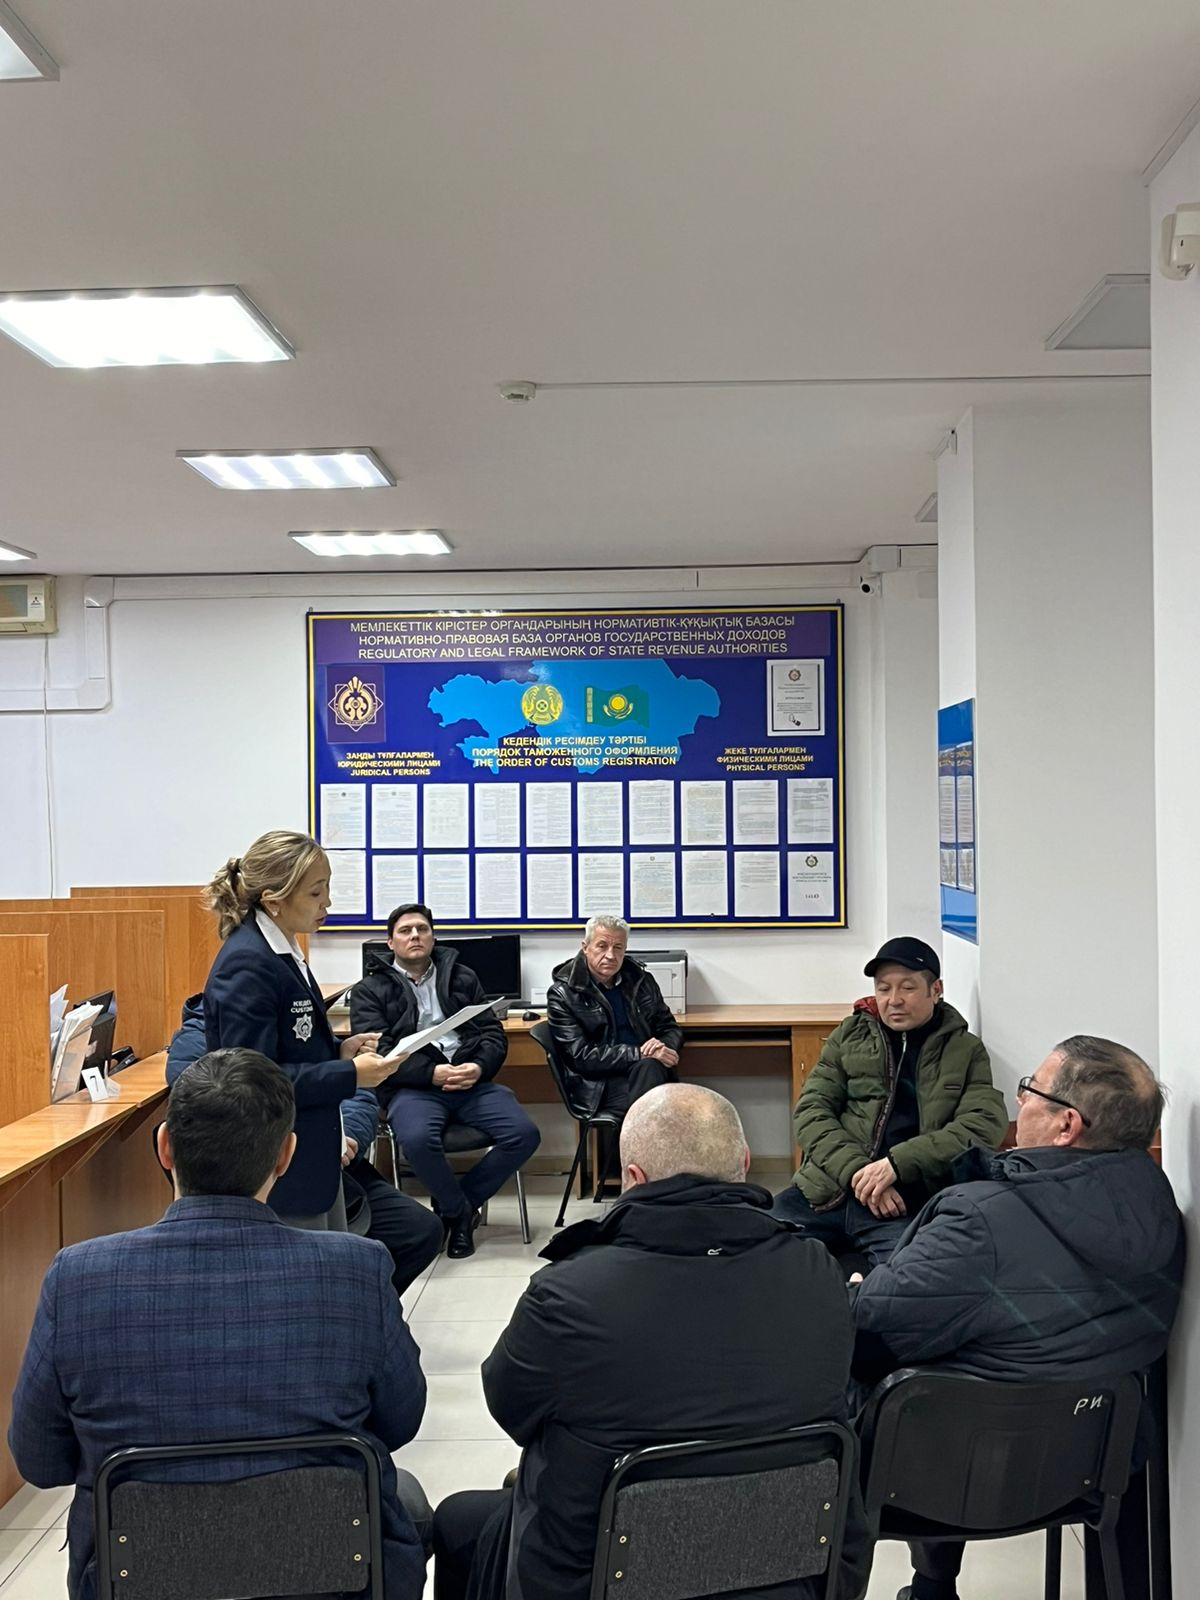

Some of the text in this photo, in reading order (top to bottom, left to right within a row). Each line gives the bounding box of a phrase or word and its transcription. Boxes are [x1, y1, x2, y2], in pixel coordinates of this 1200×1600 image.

[350, 622, 433, 633] МЕМЛЕКЕТТІК
[435, 620, 488, 632] КІРІСТЕР
[490, 619, 591, 631] ОРГАНДАРЫНЫҢ
[745, 616, 795, 626] БАЗАСЫ
[359, 629, 786, 646] НОРМАТИВНО-ПРАВОВАЯ БАЗА ОРГАНОВ ГОСУДАРСТВЕННЫХ ДОХОДОВ
[358, 642, 789, 659] REGULATORY AND LEGAL FRAMEWORK OF STATE REVENUE AUTHORITIES
[503, 735, 647, 746] КЕДЕНДІК РЕСІМДЕУ ТӘРТІБІ
[472, 746, 678, 758] ПОРЯДОК ТАМОЖЕННОГО ОФОРМЛЕНИЯ
[724, 747, 747, 755] ЖЕКЕ
[337, 759, 441, 769] ЮРИДИЧЕСКИМИ ЛИЦАМИ
[474, 756, 676, 767] THE ORDER OF CUSTOMS REGISTRATION
[716, 755, 814, 763] ФИЗИЧЕСКИМИ ЛИЦАМИ
[350, 768, 431, 777] JURIDICAL PERSONS
[726, 763, 806, 772] PHYSICAL PERSONS
